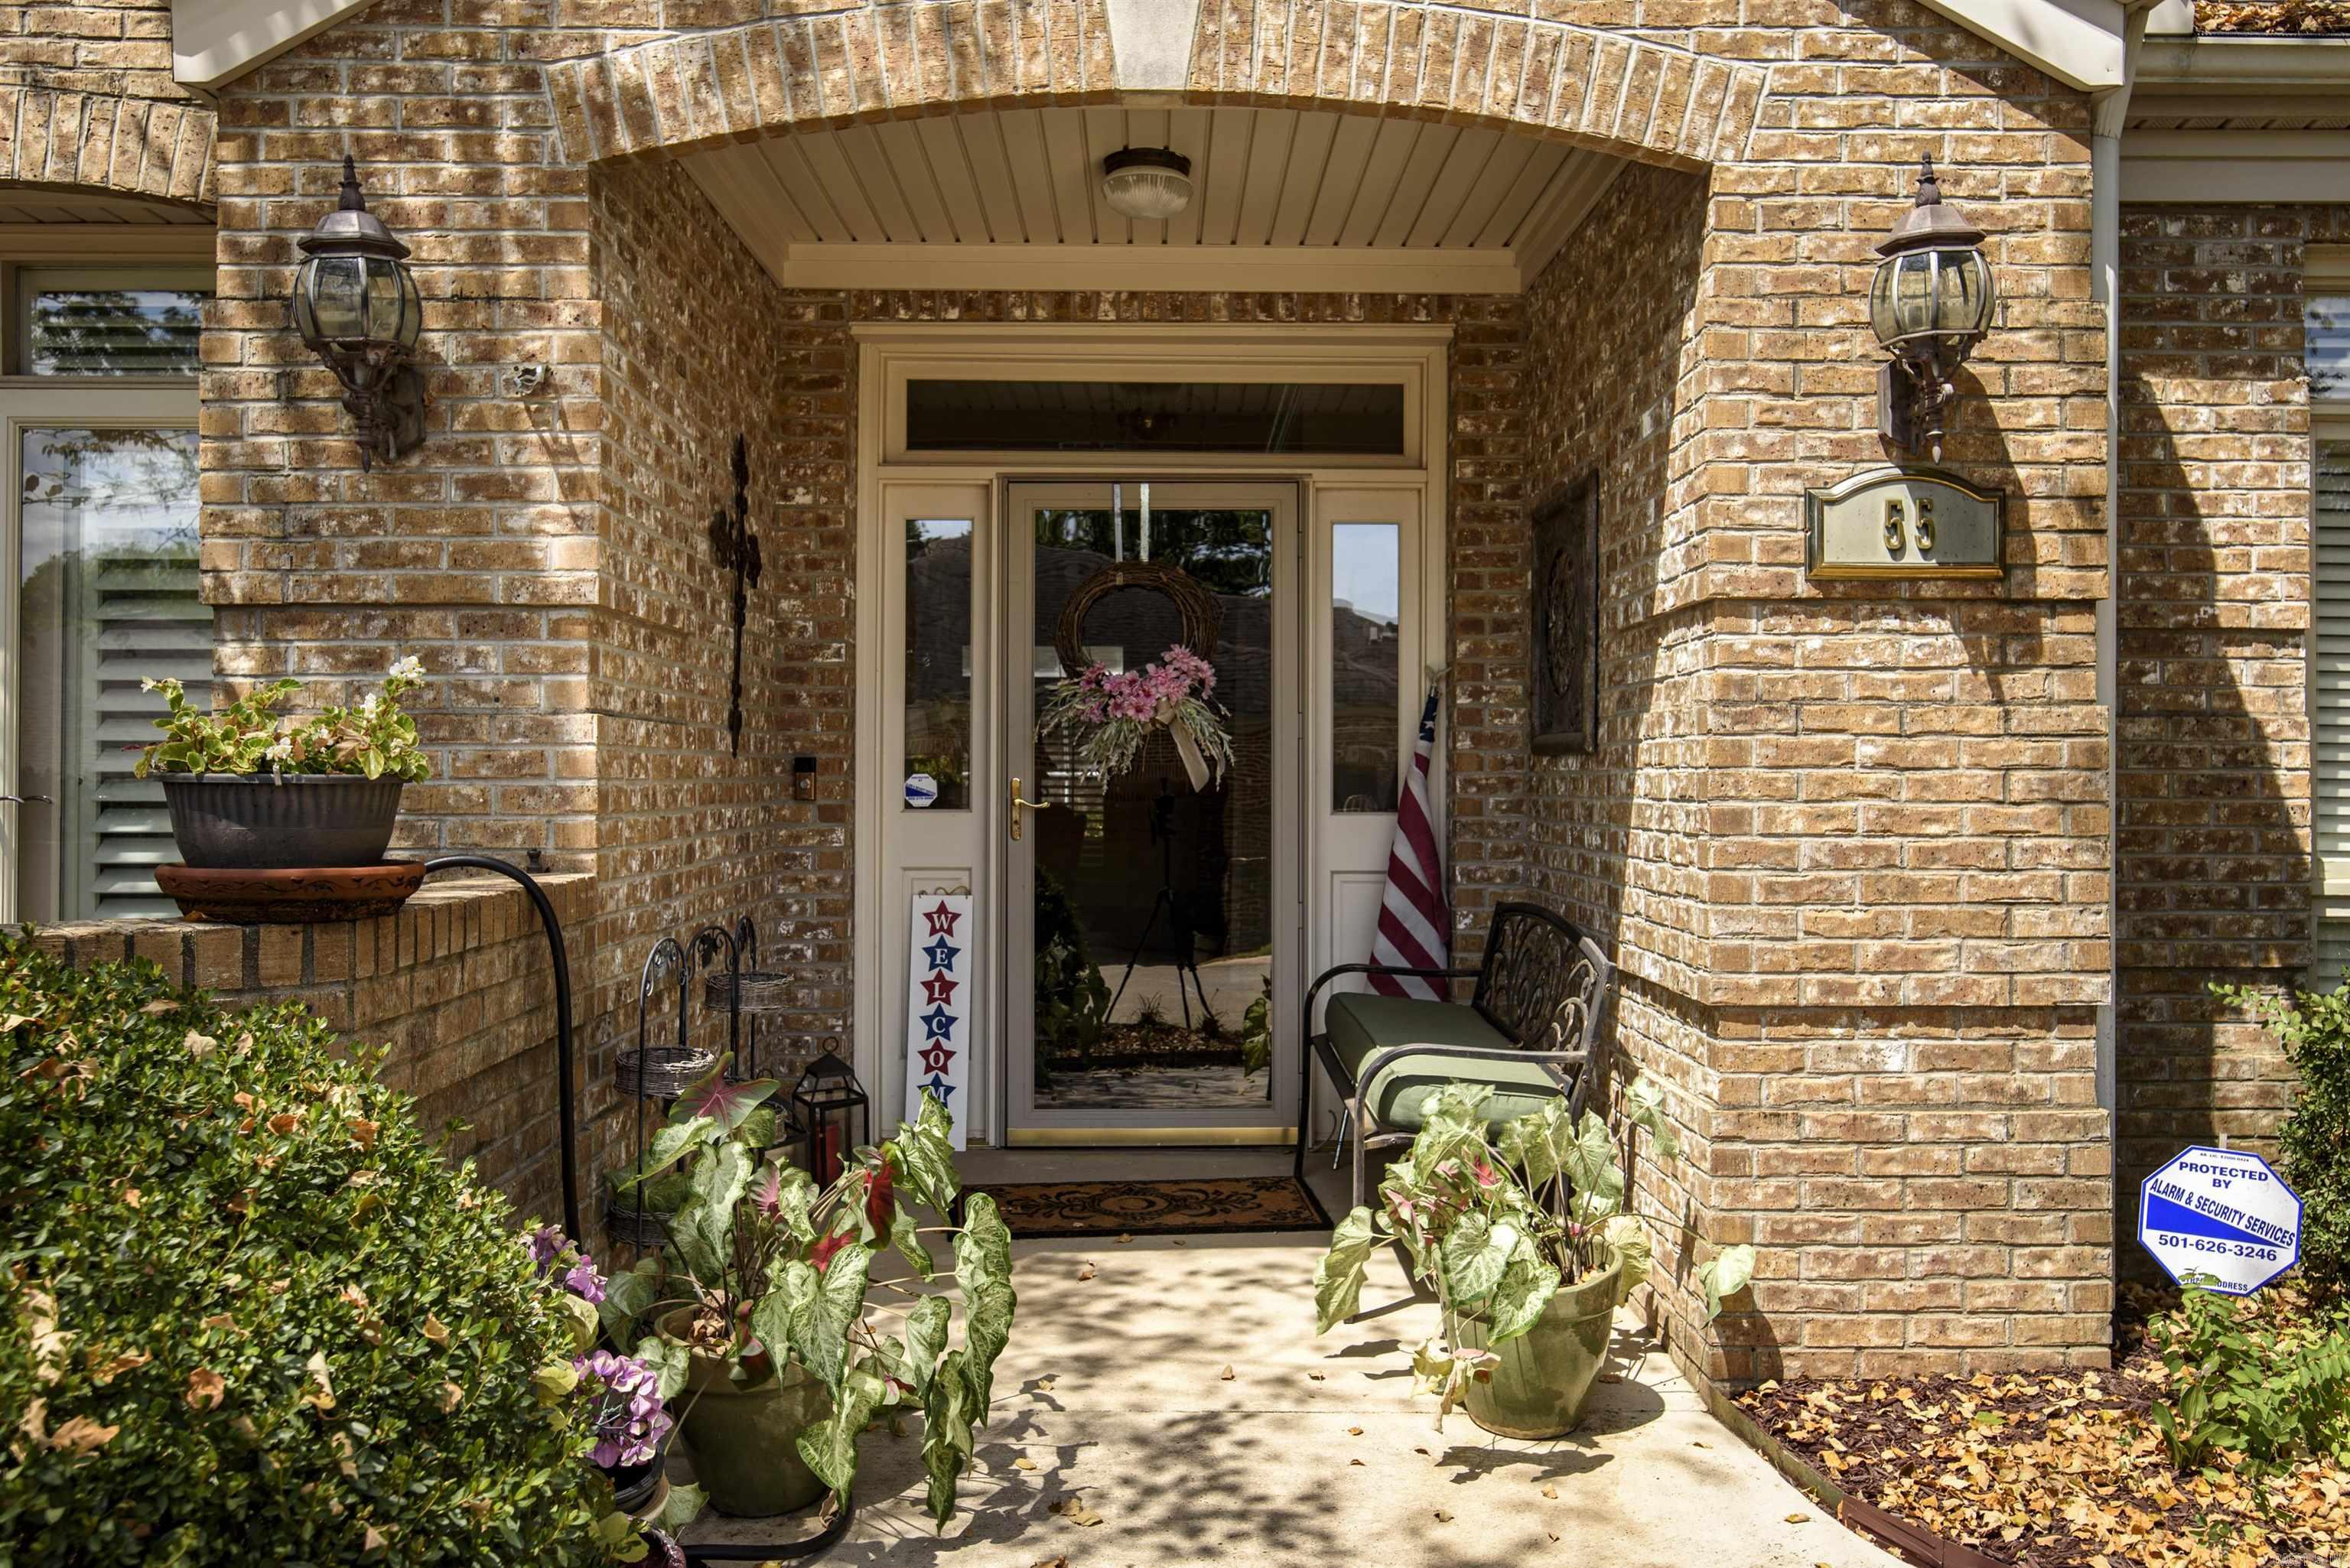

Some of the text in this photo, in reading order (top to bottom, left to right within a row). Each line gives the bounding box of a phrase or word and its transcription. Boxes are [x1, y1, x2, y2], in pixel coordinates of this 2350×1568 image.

[1884, 499, 1935, 550] 55
[928, 912, 953, 1104] WELCOM
[2179, 1161, 2268, 1182] PROTECTED
[2212, 1178, 2232, 1189] BY
[2150, 1178, 2296, 1247] ALARM & SECURITY SERVICES
[2158, 1234, 2277, 1261] 501-626-3246
[2215, 1280, 2248, 1292] DDRESS
